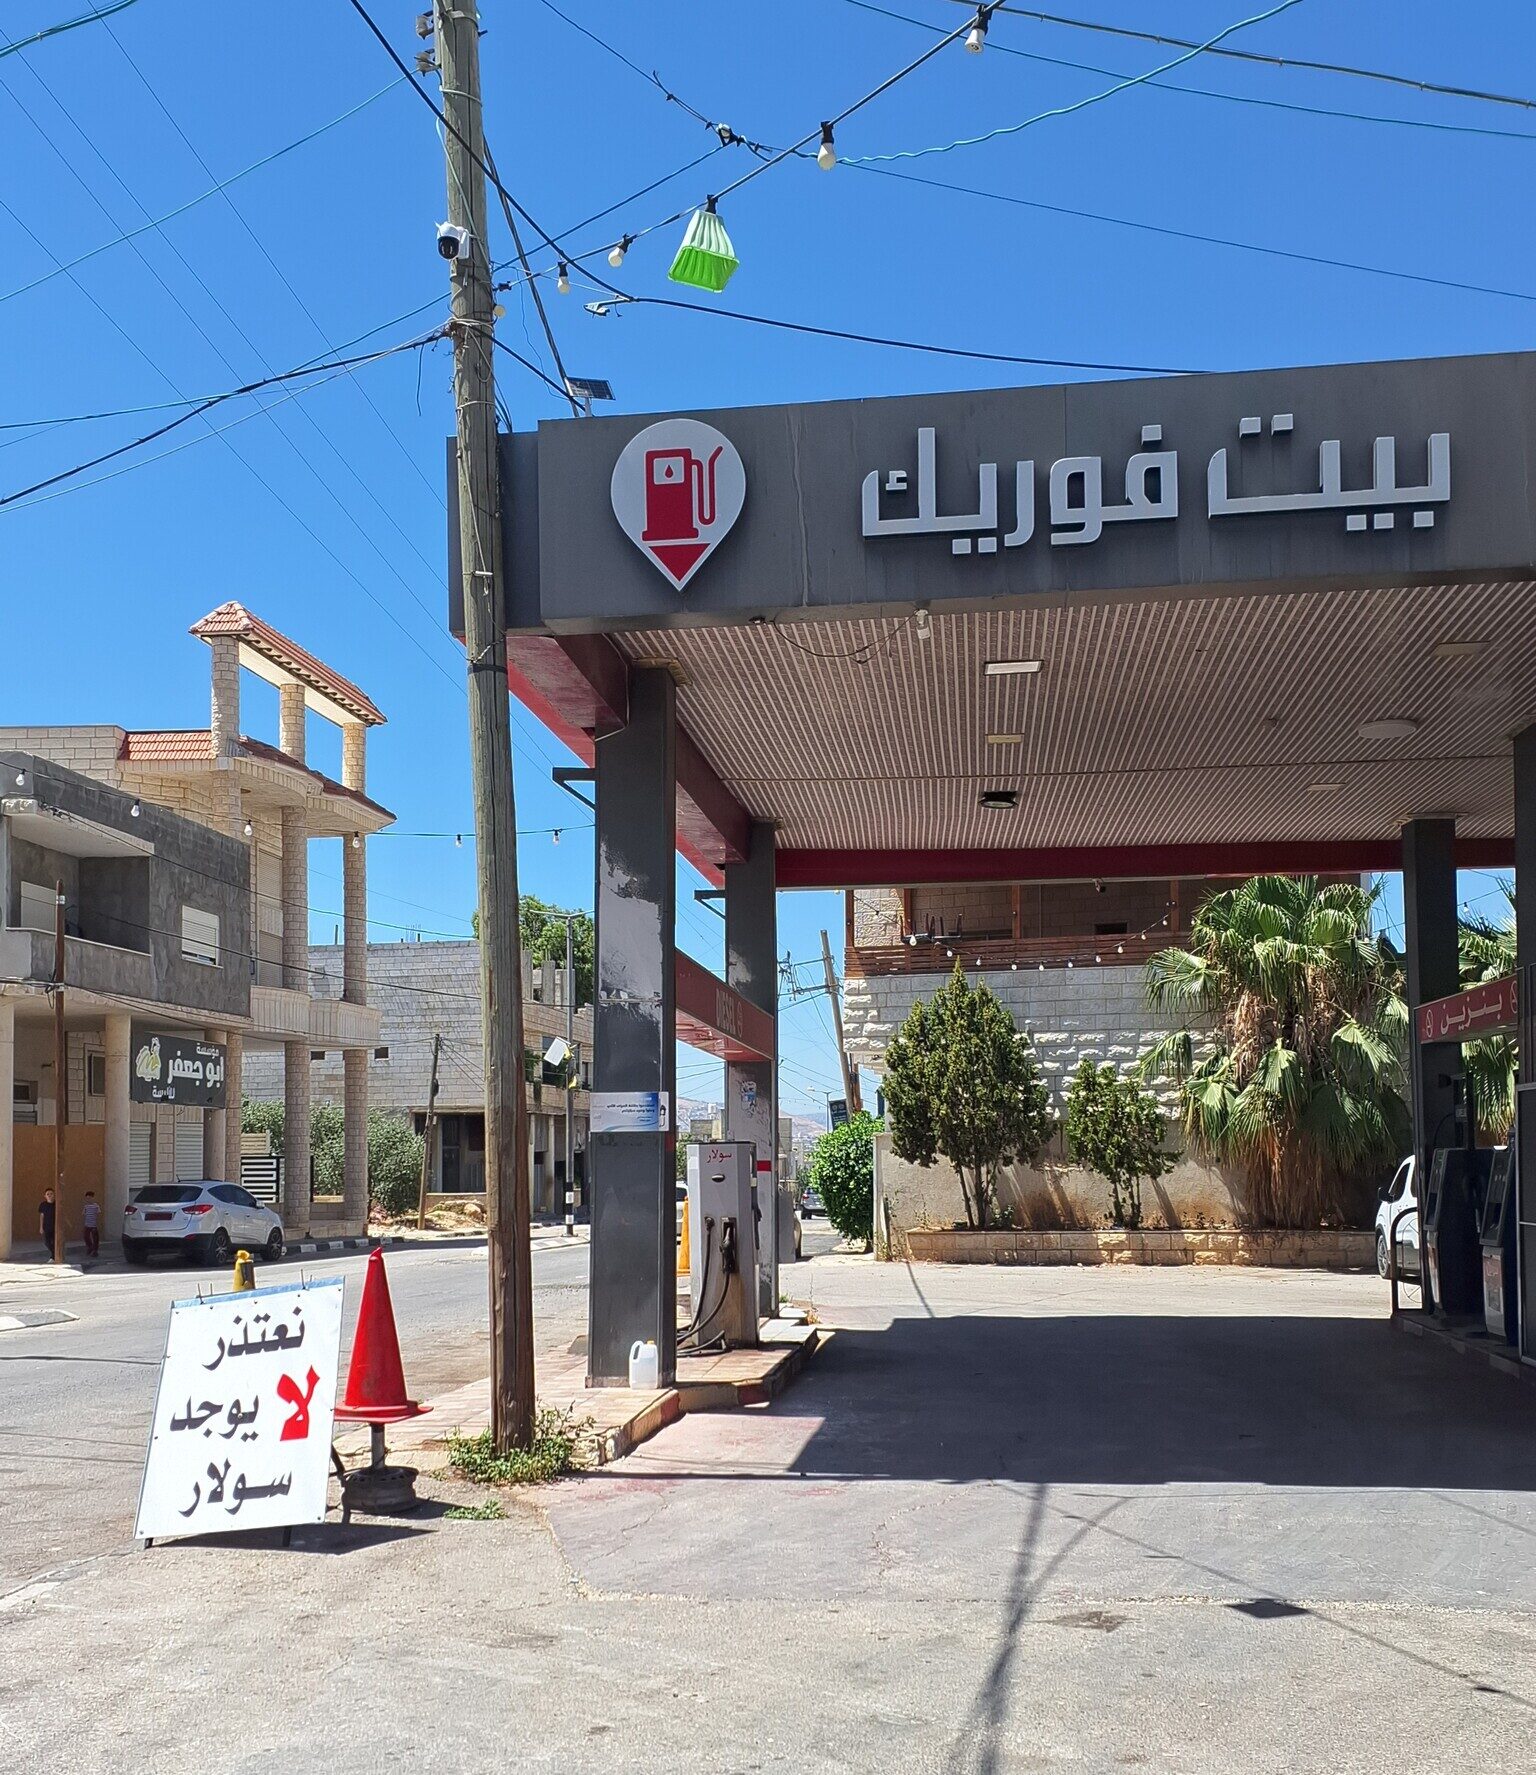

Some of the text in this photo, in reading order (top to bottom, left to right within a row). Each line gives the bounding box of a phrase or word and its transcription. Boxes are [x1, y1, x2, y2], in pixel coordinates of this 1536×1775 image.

[861, 413, 1451, 555] بيت فوريك
[1440, 989, 1503, 1035] بنزين
[167, 1050, 204, 1086] جعفر
[706, 1149, 732, 1163] سولار
[202, 1306, 305, 1371] نعتذر
[170, 1365, 320, 1442] لا يوجد
[178, 1457, 293, 1518] سولار
